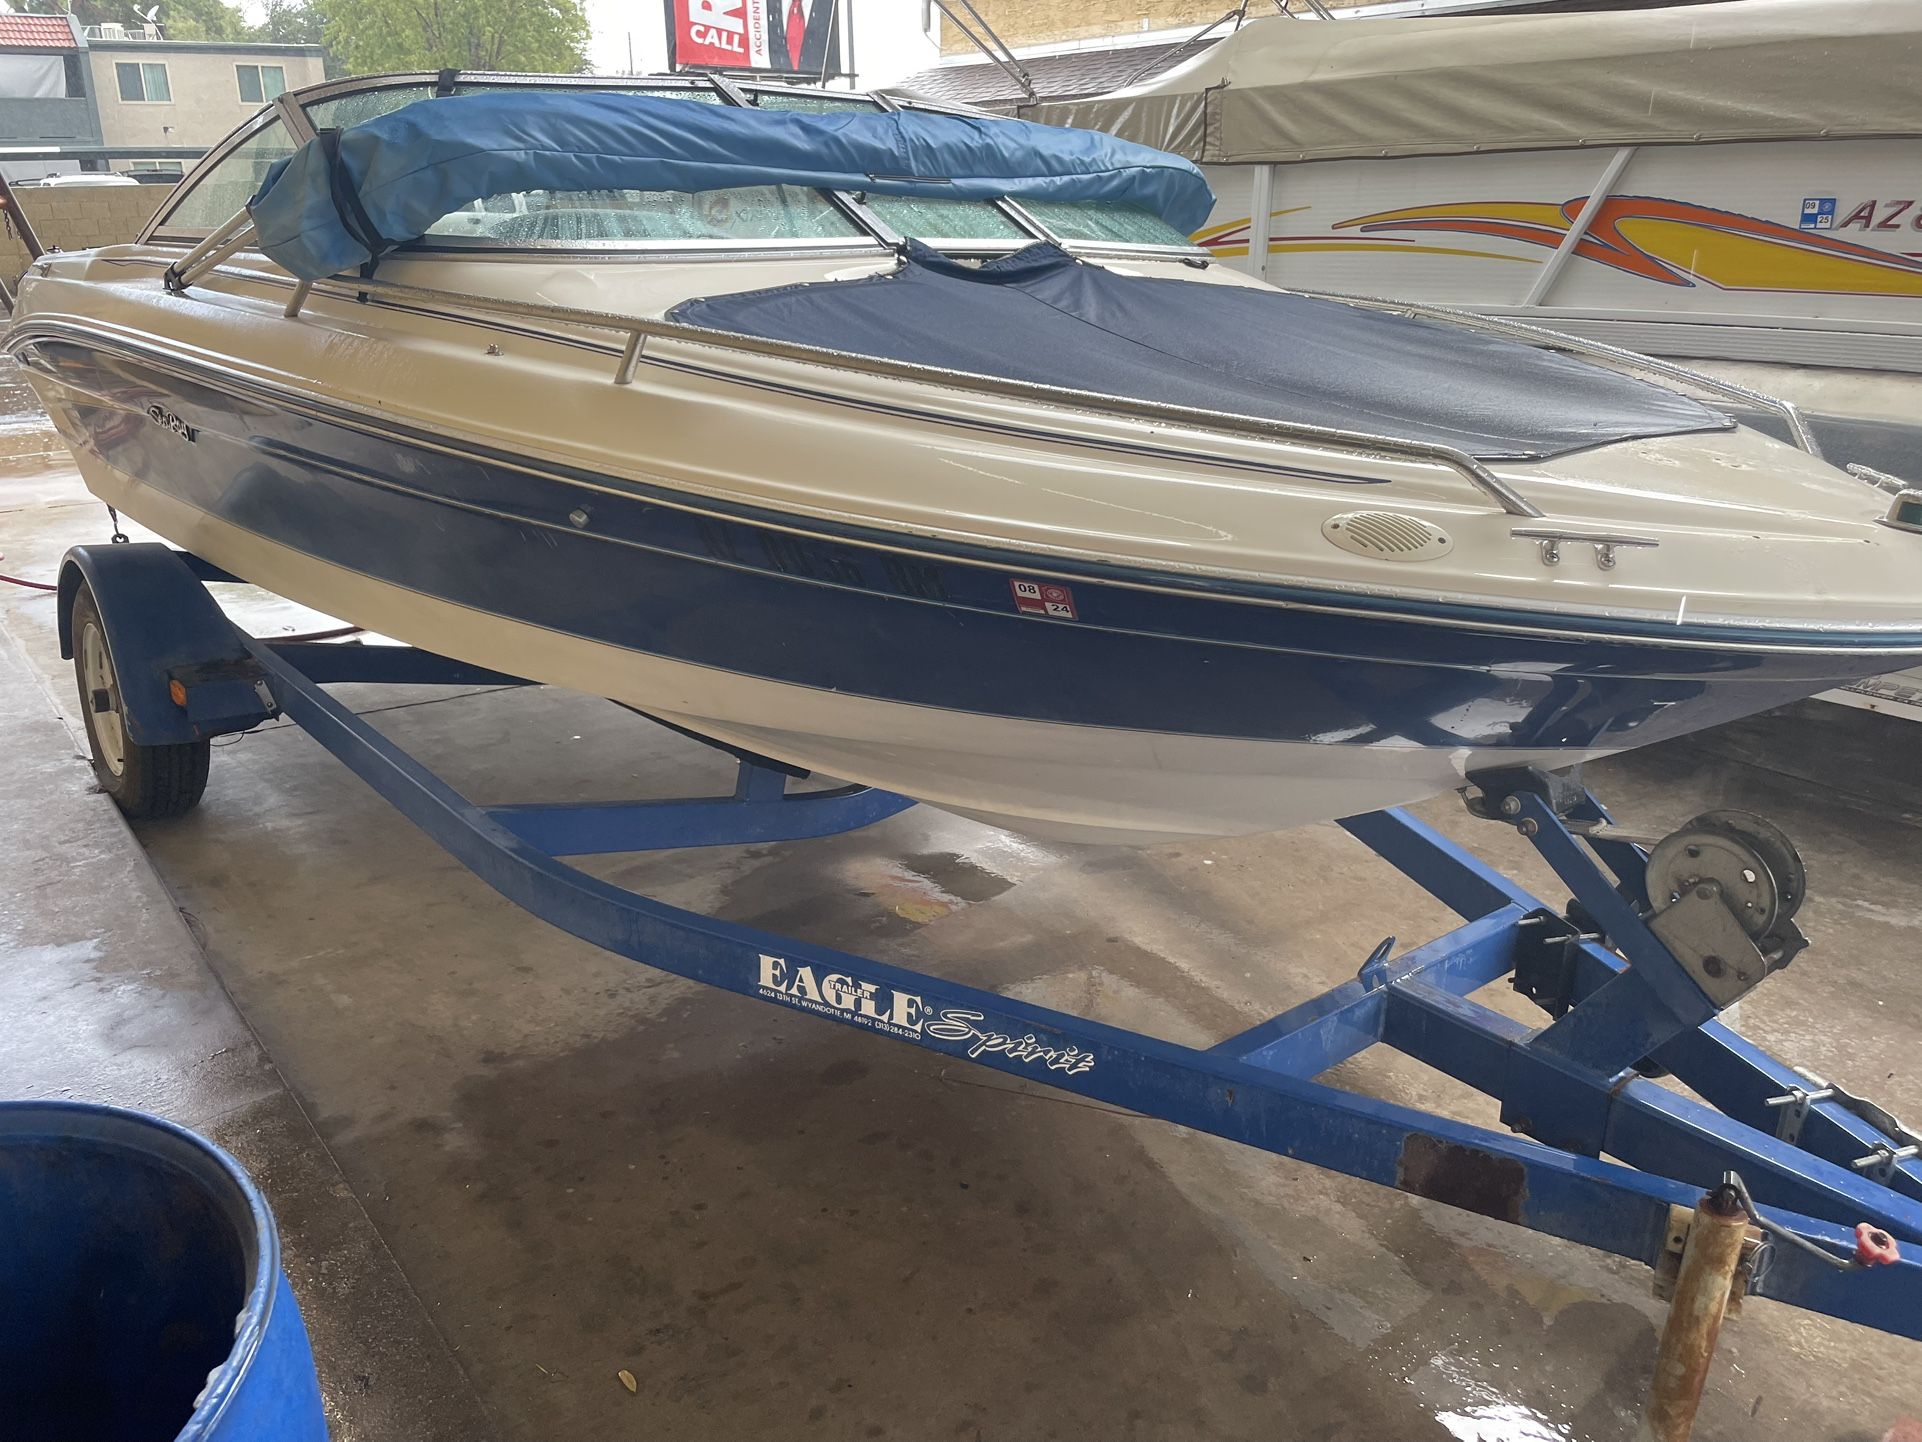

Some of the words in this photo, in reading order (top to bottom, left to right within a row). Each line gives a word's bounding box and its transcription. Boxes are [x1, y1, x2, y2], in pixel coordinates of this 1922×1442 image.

[689, 24, 745, 54] CALL
[1804, 202, 1816, 210] 09
[1818, 215, 1830, 224] 25
[1018, 583, 1036, 594] 08
[1051, 603, 1070, 613] 24
[829, 979, 871, 999] TRAILER
[758, 987, 775, 998] 4624
[776, 992, 791, 1002] 13TH
[843, 1012, 852, 1020] MI
